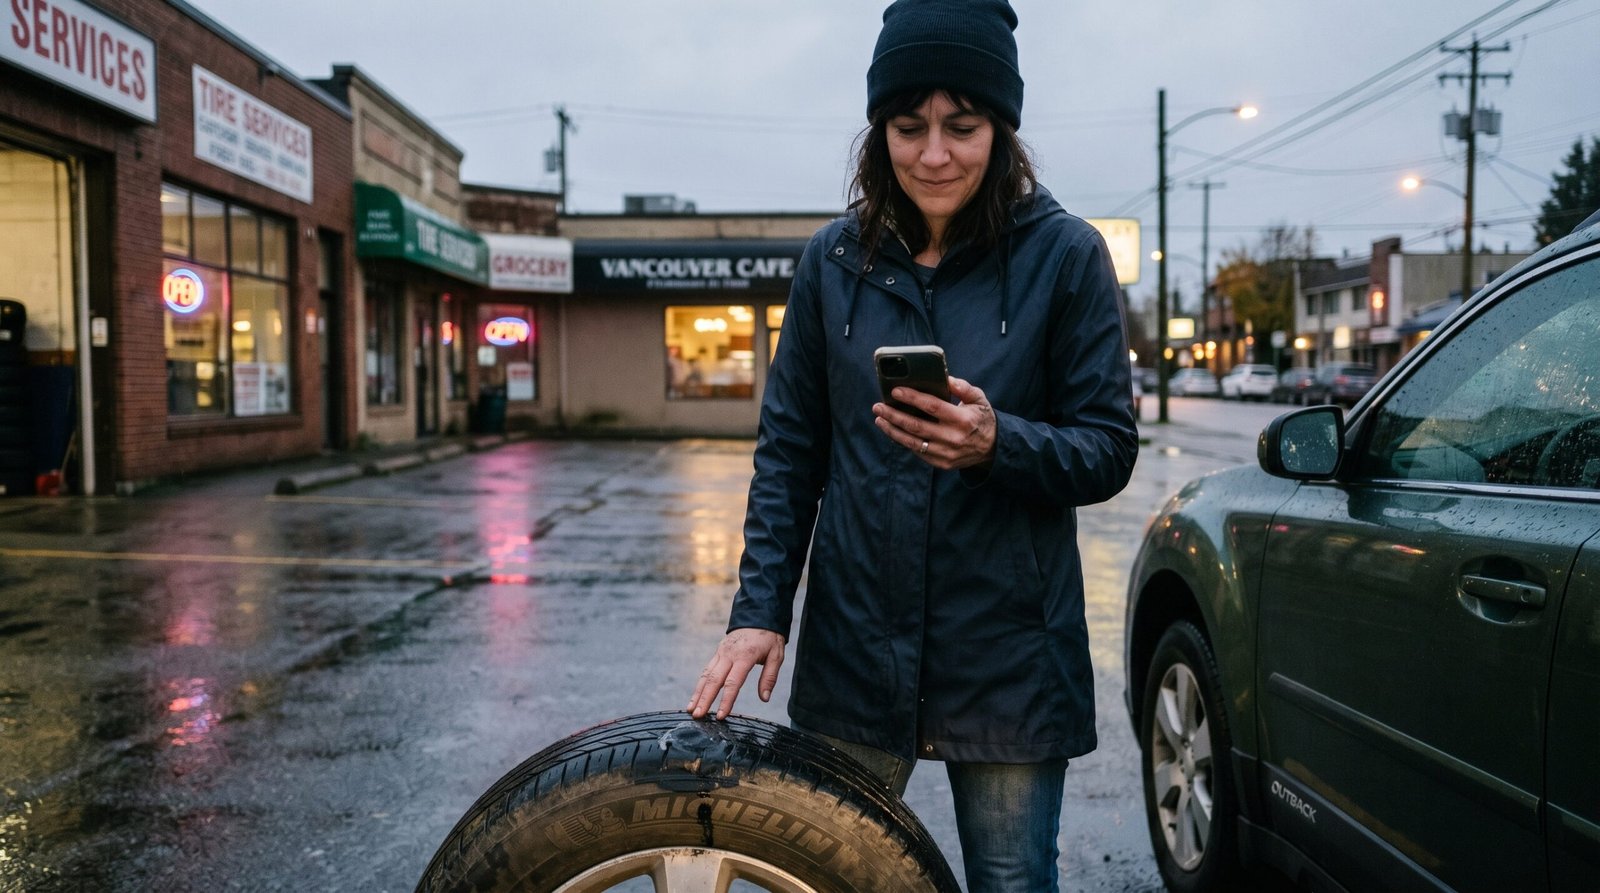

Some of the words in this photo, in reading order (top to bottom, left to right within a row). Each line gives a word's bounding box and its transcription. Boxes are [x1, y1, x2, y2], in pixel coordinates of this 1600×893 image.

[11, 0, 147, 102] SERVICES
[199, 76, 237, 124] TIRE
[243, 100, 308, 158] SERVICES
[493, 255, 567, 277] GROCERY
[601, 258, 732, 277] VANCOUVER
[736, 258, 795, 278] CAFE
[632, 796, 833, 854] MICHELIN
[1271, 780, 1317, 823] OUTBACK
